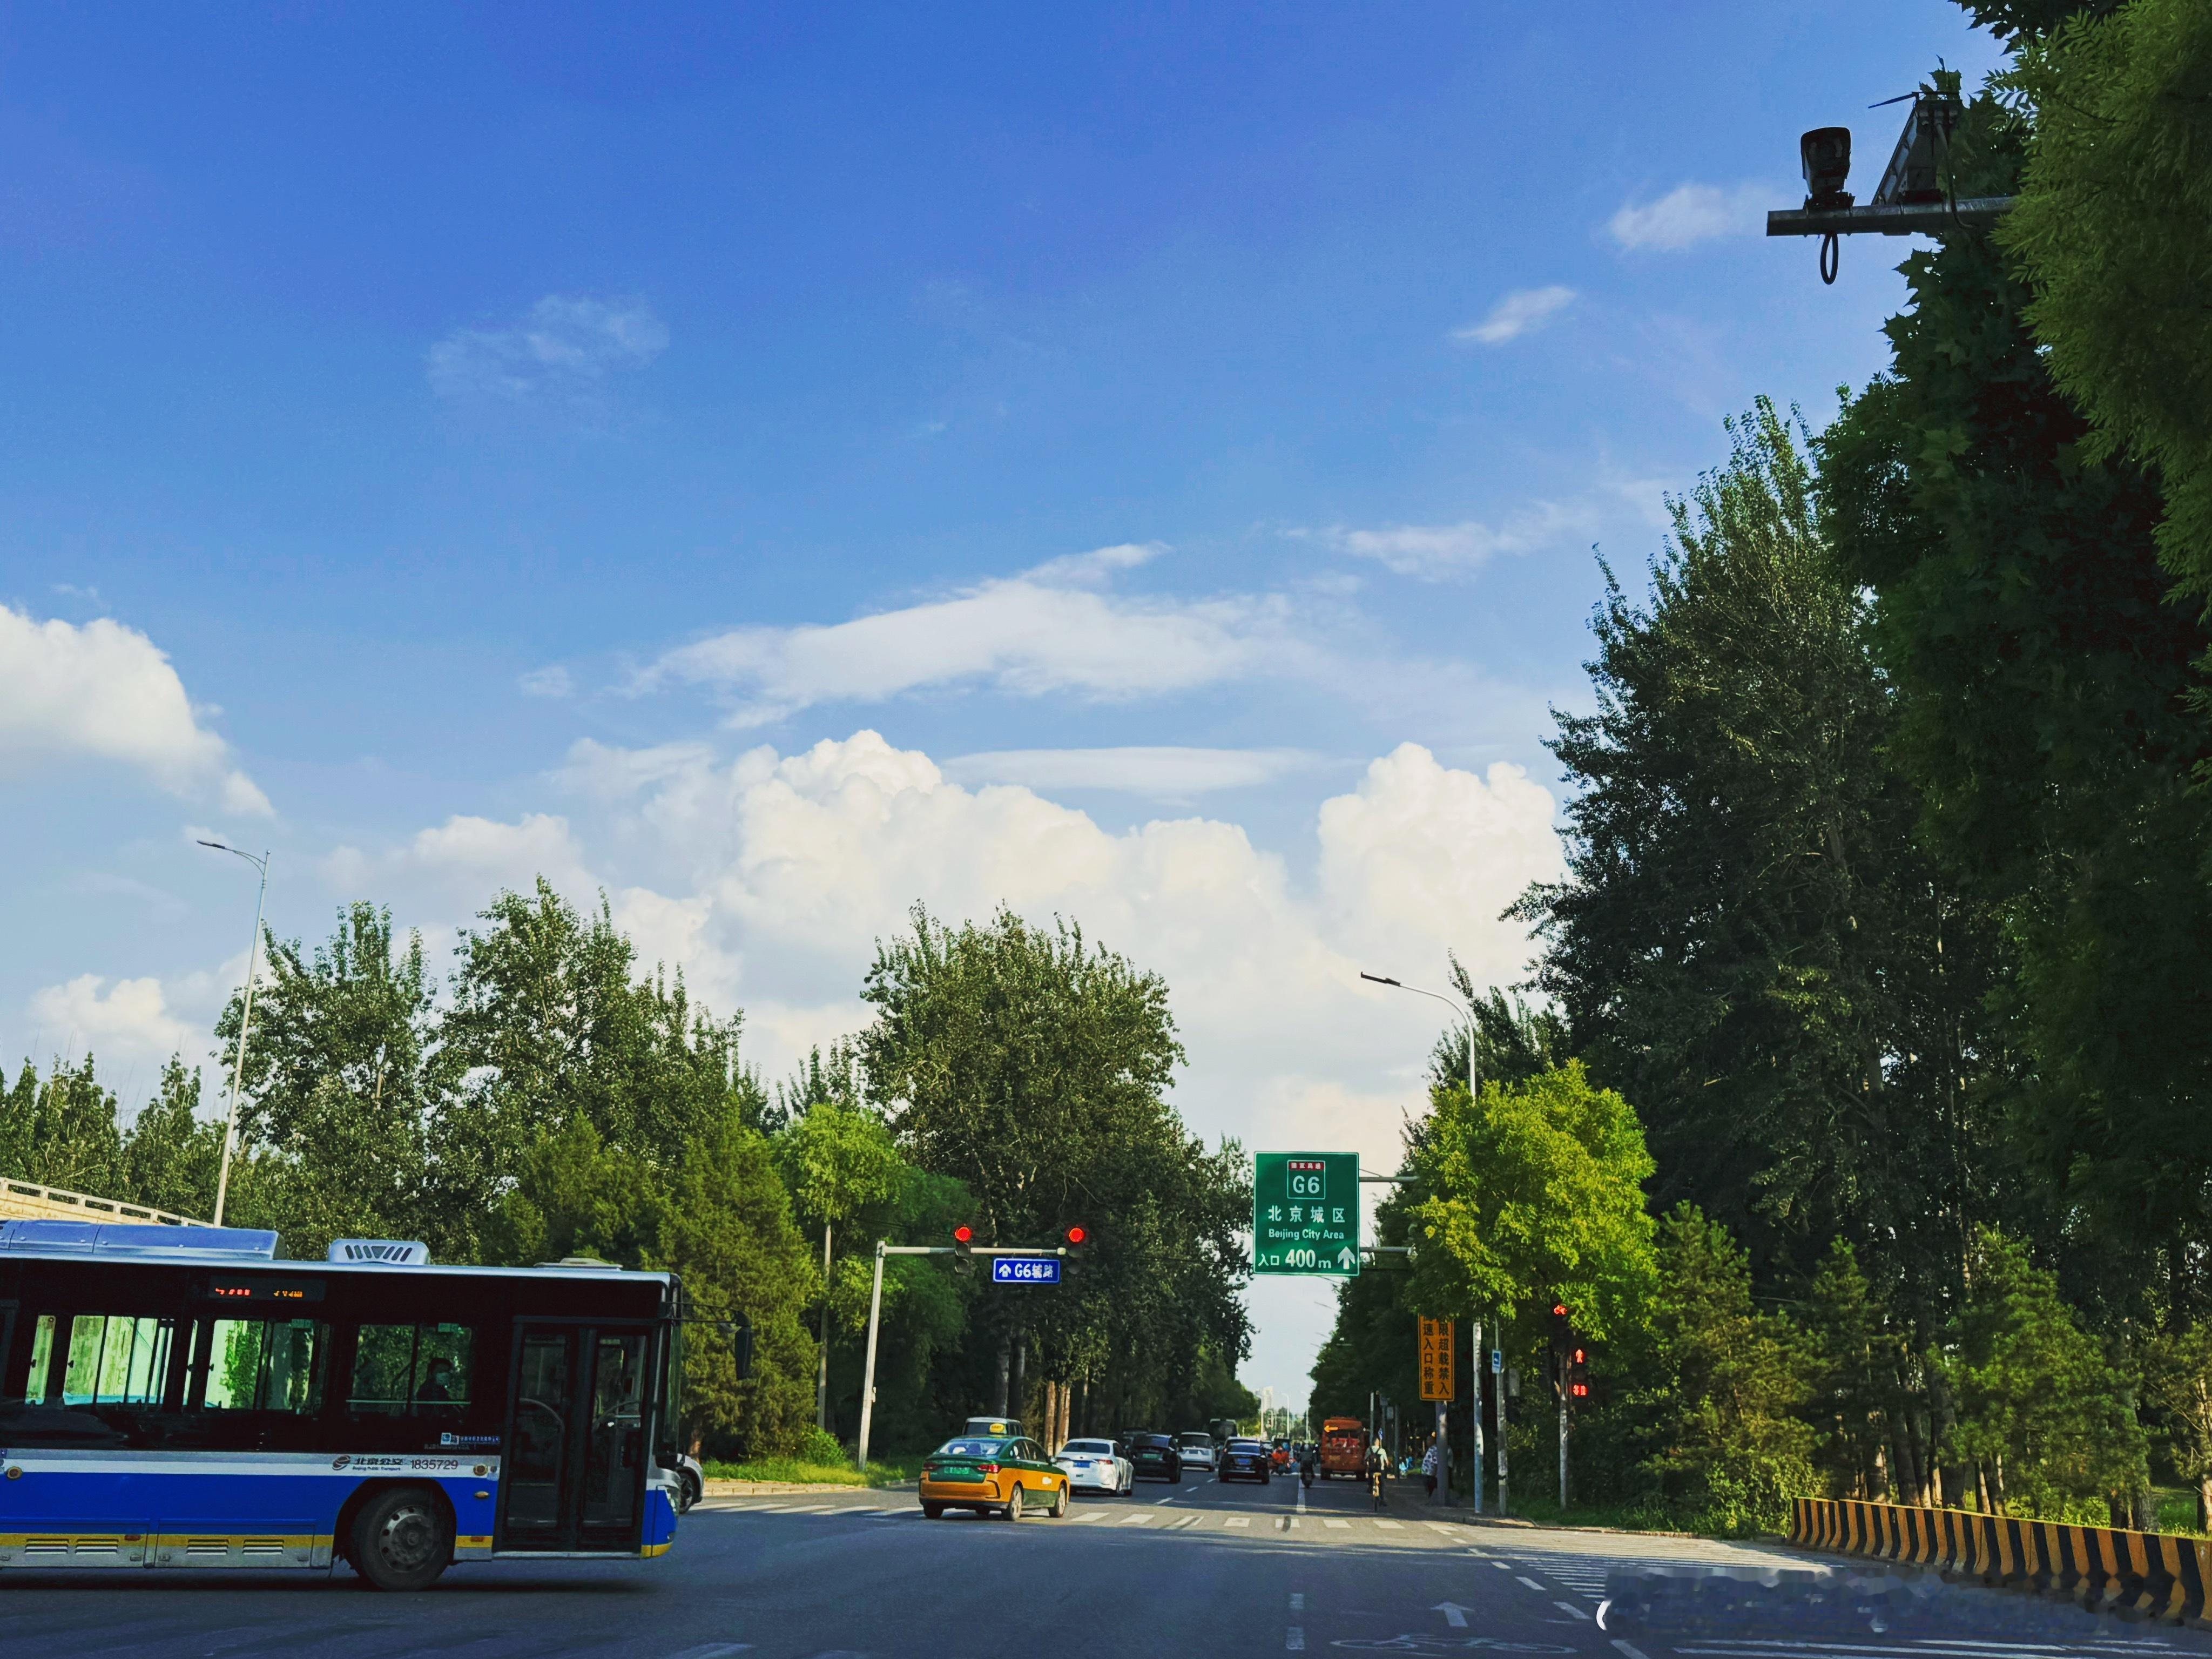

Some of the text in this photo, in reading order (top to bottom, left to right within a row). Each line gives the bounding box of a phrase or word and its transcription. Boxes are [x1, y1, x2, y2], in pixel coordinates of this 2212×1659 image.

[1292, 1175, 1320, 1194] G6
[1268, 1205, 1345, 1223] 北京城区
[1269, 1228, 1344, 1240] Beijing City Area
[1258, 1253, 1279, 1266] 入口
[1423, 1316, 1434, 1394] 速入口称重
[1438, 1323, 1449, 1395] 限超载禁入
[410, 1459, 458, 1470] 1835729
